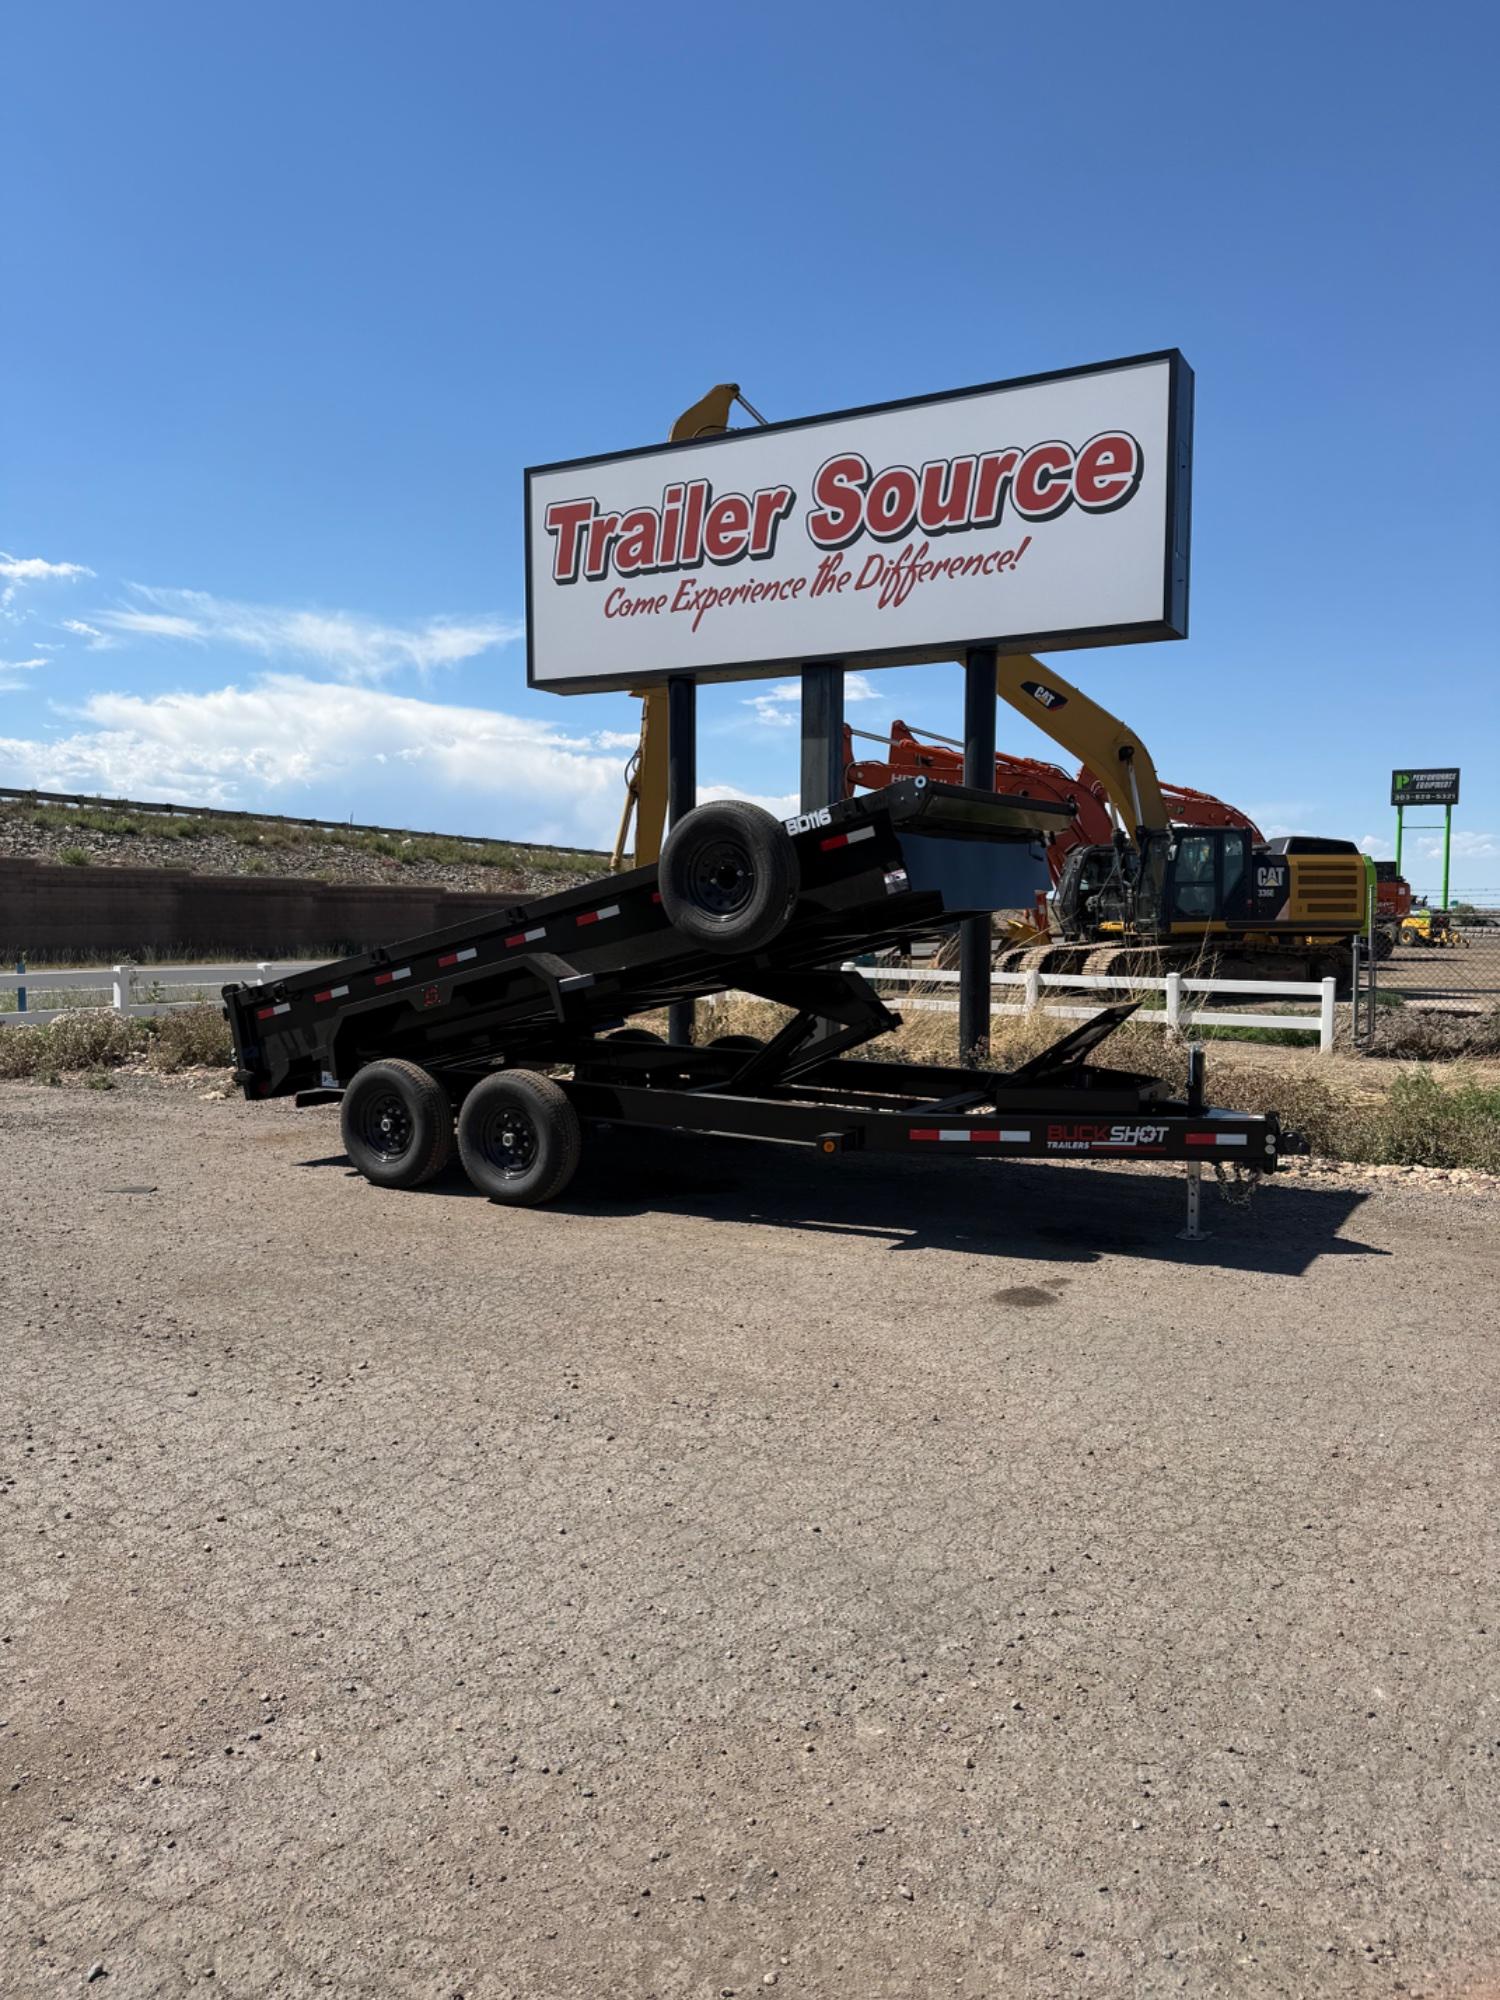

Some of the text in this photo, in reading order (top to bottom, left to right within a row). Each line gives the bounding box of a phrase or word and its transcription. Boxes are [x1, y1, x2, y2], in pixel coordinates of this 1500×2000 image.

[545, 430, 1144, 585] Trailer Source
[603, 536, 1032, 633] Come Experience the Difference!
[1034, 686, 1056, 707] CAT
[1257, 866, 1285, 887] CAT
[1046, 1124, 1170, 1143] BUCKSHOT
[1046, 1141, 1090, 1150] TRAILERS
